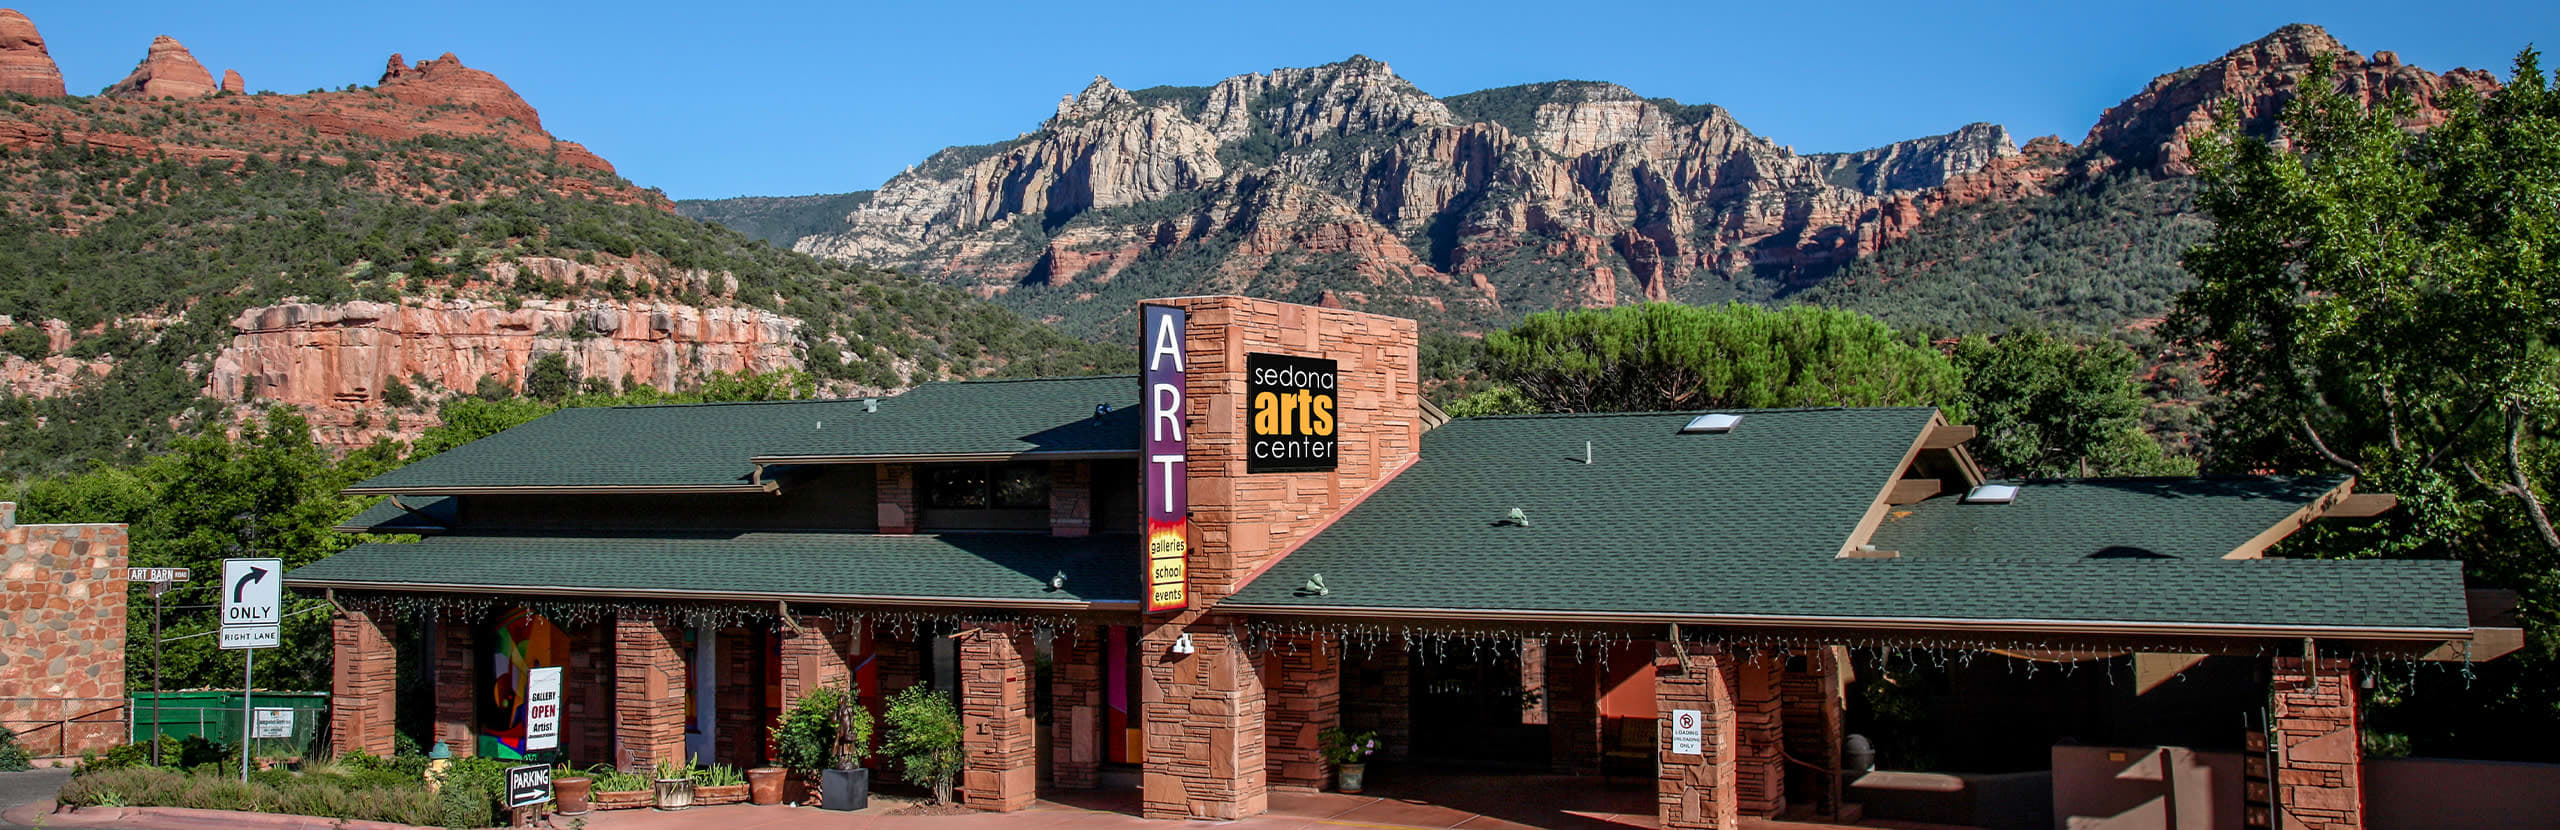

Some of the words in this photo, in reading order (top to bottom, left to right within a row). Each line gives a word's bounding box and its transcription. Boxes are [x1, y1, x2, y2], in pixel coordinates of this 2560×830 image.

[1255, 365, 1334, 390] sedona
[1151, 314, 1184, 513] ART
[1254, 389, 1334, 437] arts
[1255, 436, 1333, 459] center
[1151, 537, 1185, 555] galleries
[131, 569, 147, 580] ART
[151, 569, 173, 580] BARN
[1155, 564, 1182, 580] school
[1155, 586, 1182, 602] events
[230, 606, 272, 620] ONLY
[224, 633, 251, 642] RIGHT
[254, 632, 275, 641] LANE
[532, 691, 556, 702] GALLERY
[531, 704, 556, 719] OPEN
[533, 722, 552, 732] Artist
[513, 769, 549, 790] PARKING
